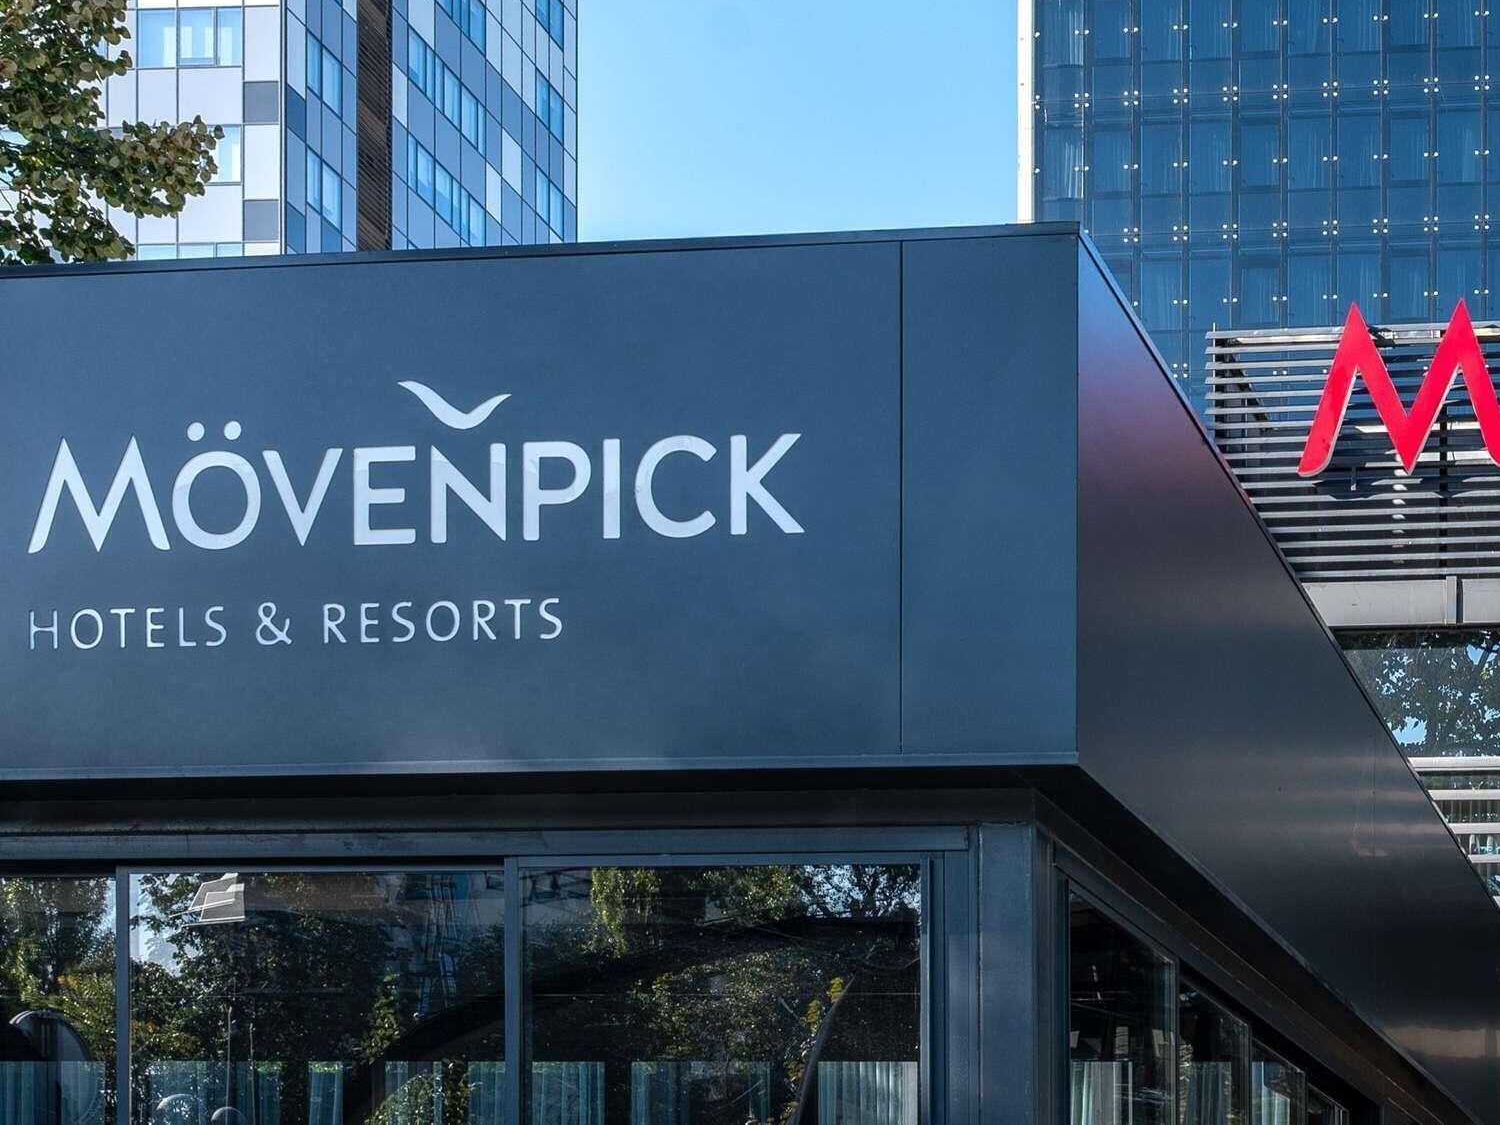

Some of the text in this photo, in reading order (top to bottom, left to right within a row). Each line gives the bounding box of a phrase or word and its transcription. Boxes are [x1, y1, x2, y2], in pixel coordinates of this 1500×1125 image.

[27, 420, 805, 554] MÖVENPICK
[28, 597, 563, 650] HOTELS & RESORTS
